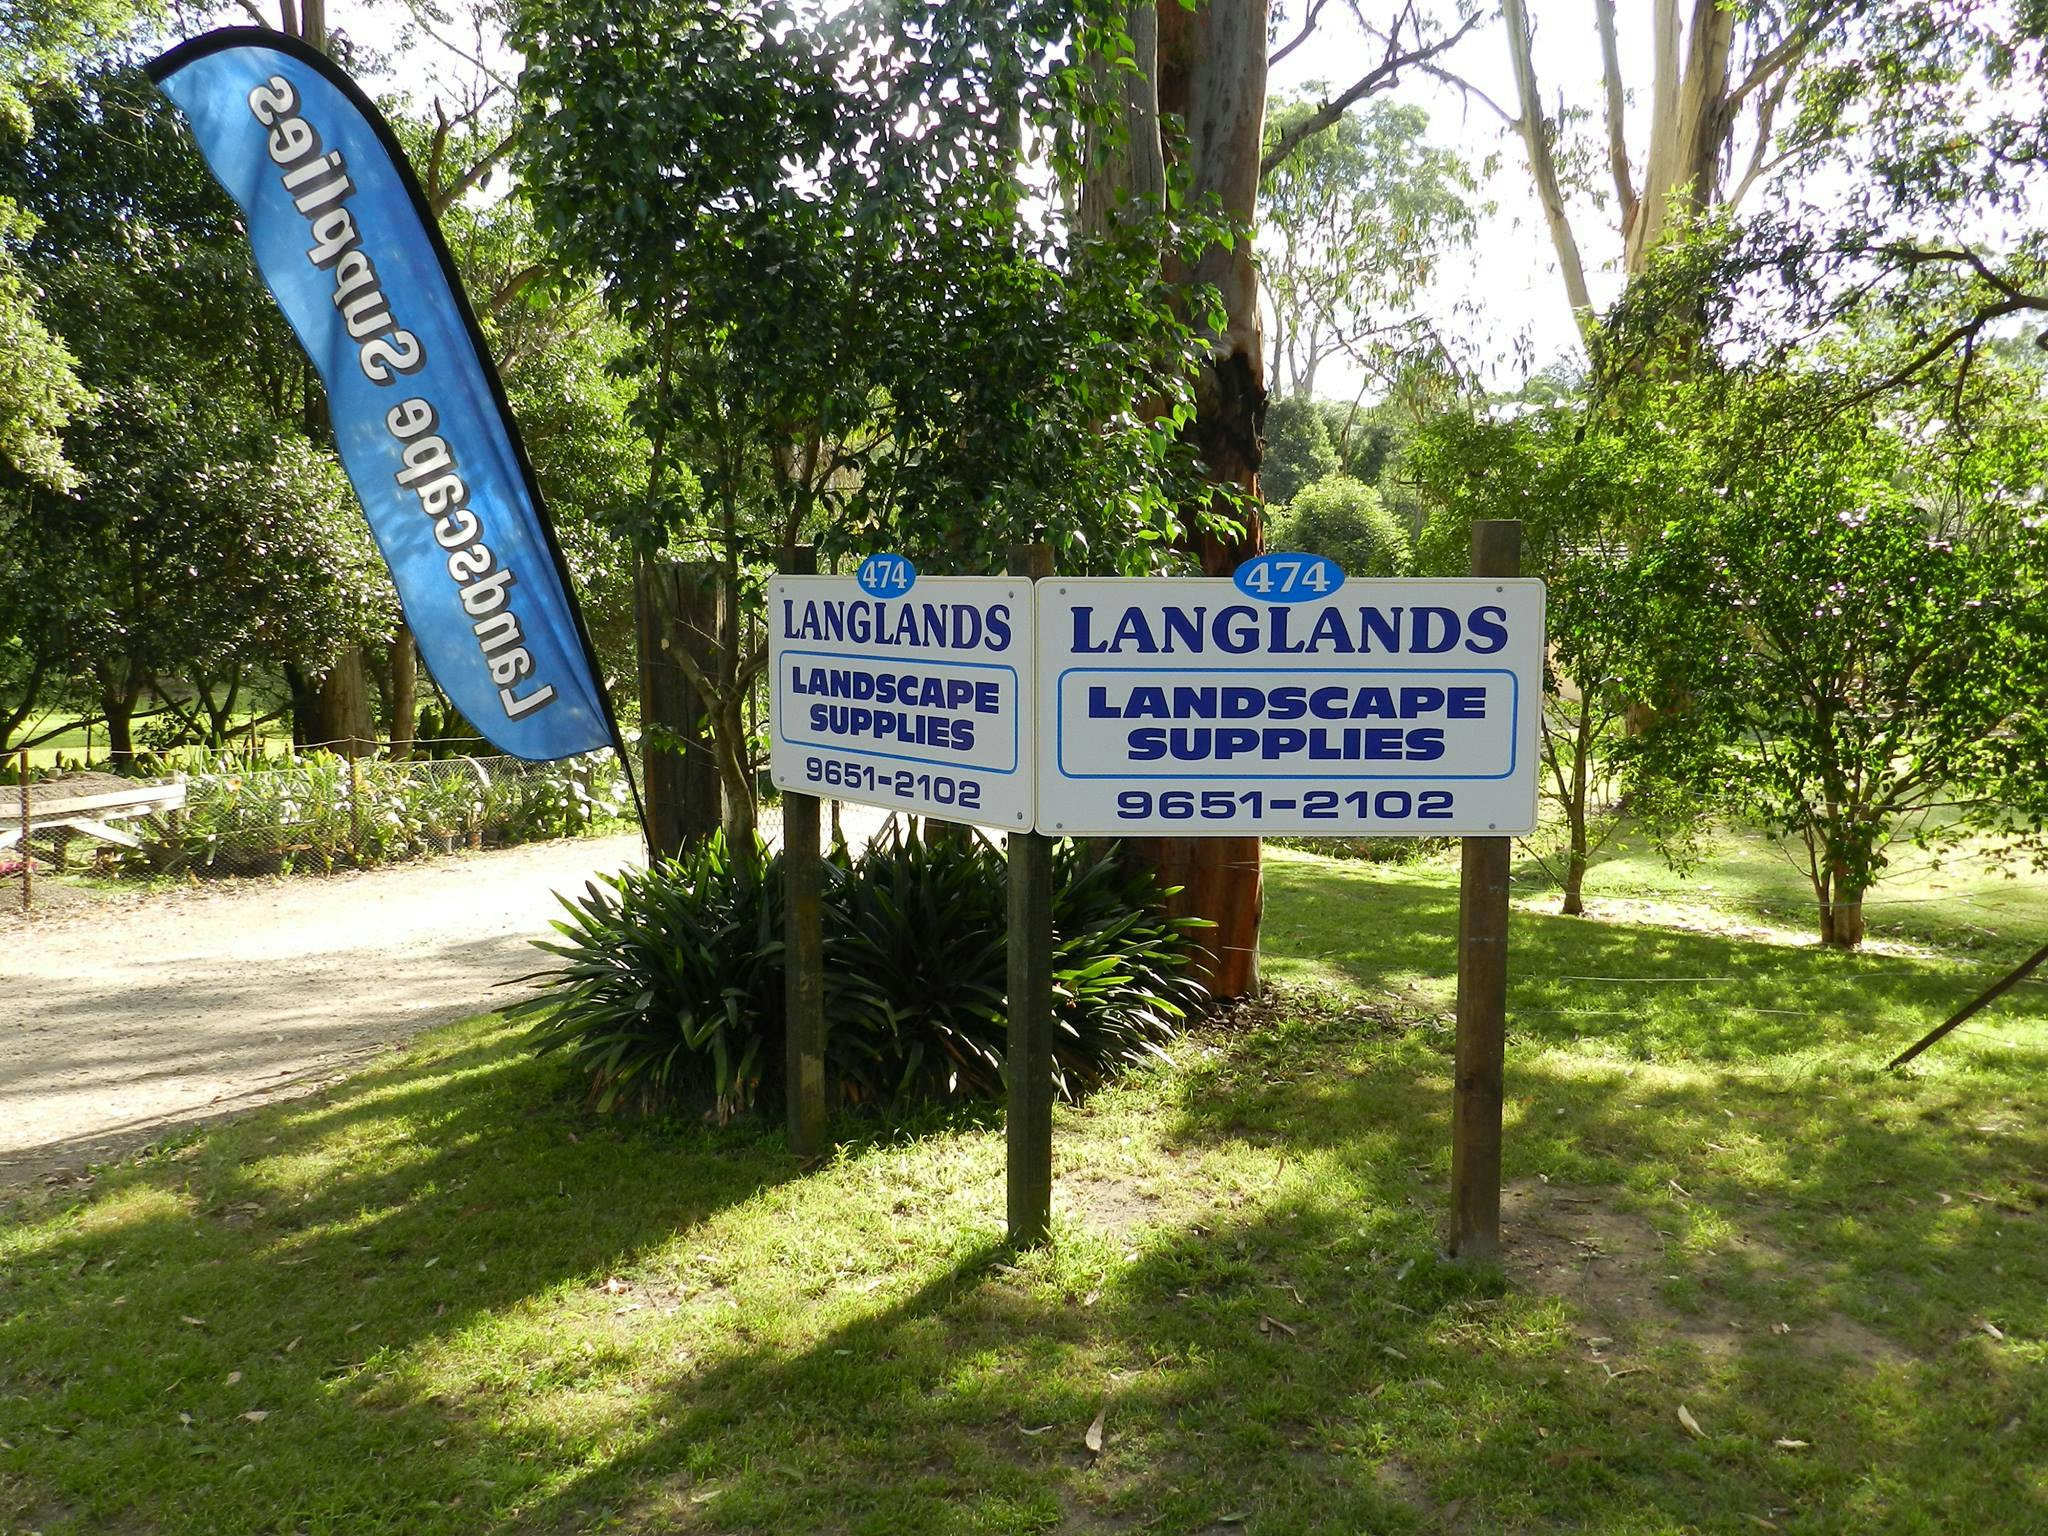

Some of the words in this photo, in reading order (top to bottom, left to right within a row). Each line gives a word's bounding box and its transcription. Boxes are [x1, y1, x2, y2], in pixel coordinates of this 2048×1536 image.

[862, 560, 907, 589] 474
[1244, 561, 1331, 593] 474
[783, 599, 1012, 651] LANGLANDS
[1070, 606, 1508, 654] LANGLANDS
[791, 666, 1000, 714] LANDSCAPE
[1088, 686, 1486, 719] LANDSCAPE
[810, 703, 975, 751] SUPPLIES
[1127, 728, 1445, 761] SUPPLIES
[805, 757, 981, 809] 9651-2102
[1117, 791, 1454, 819] 9651-2102
